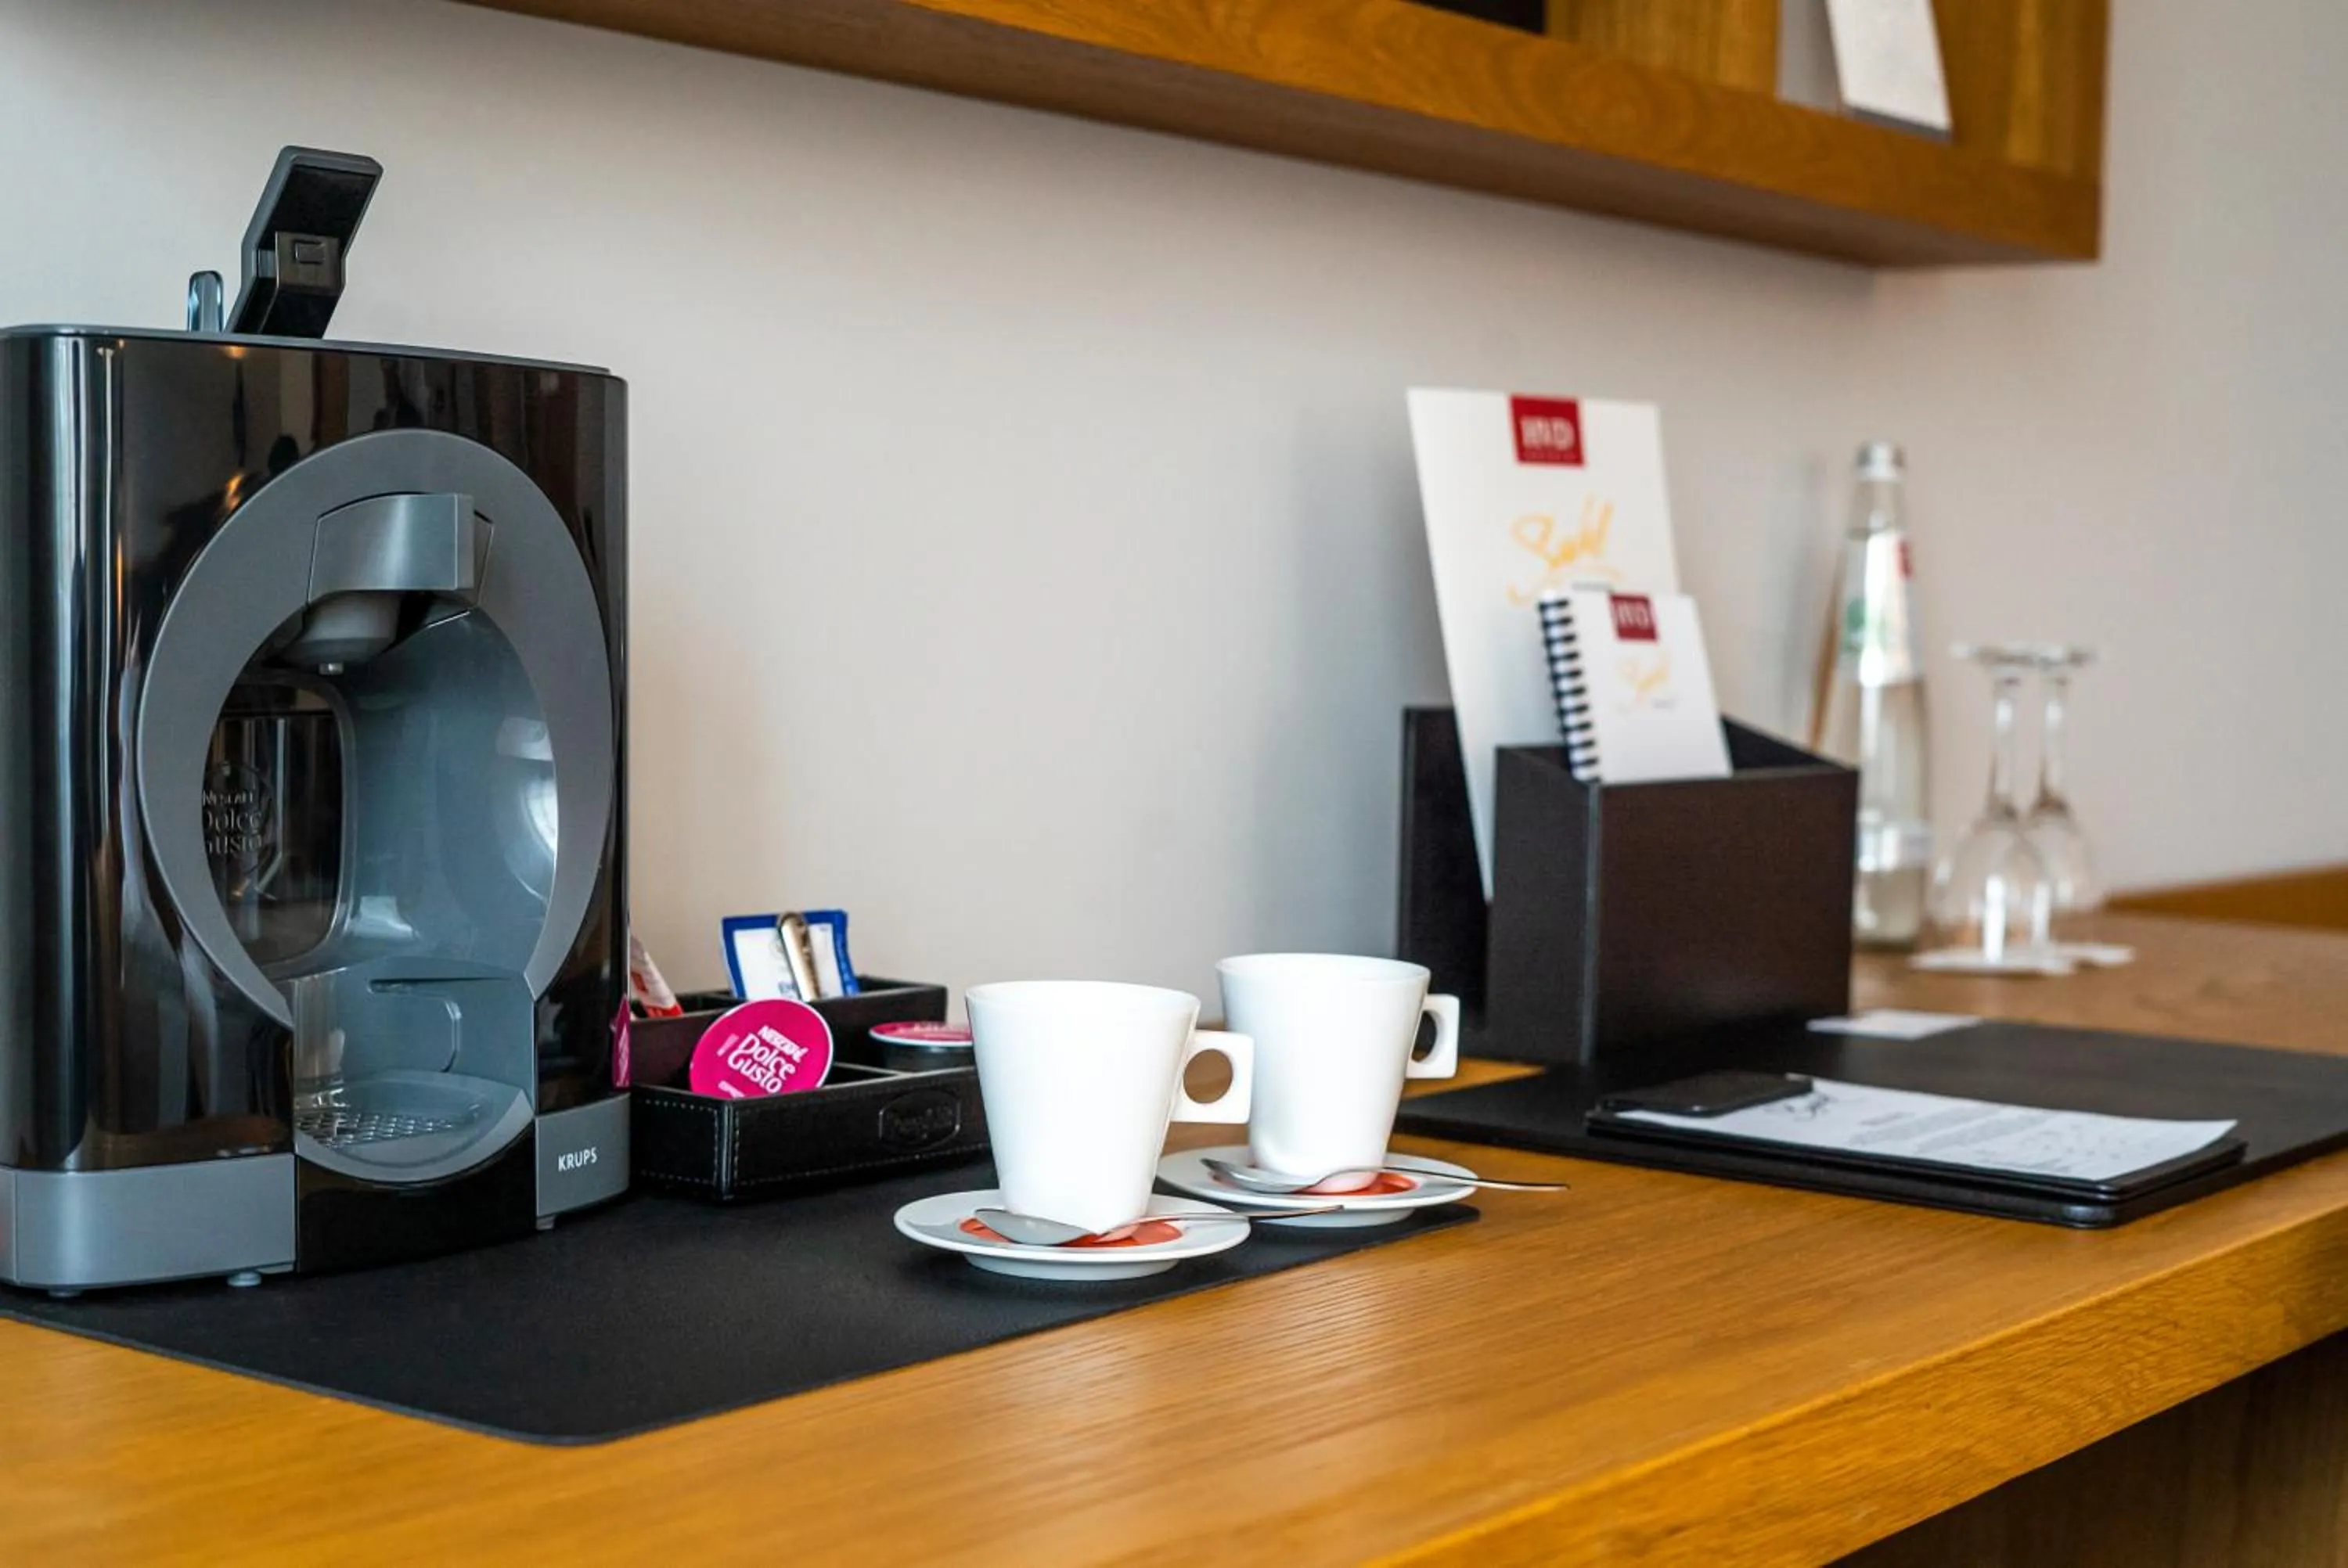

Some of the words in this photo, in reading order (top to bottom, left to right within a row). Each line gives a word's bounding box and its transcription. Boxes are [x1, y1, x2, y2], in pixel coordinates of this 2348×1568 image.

[207, 834, 262, 858] usto
[727, 1049, 783, 1094] Gusto
[736, 1033, 796, 1081] Dolce
[558, 1145, 598, 1172] KRUPS
